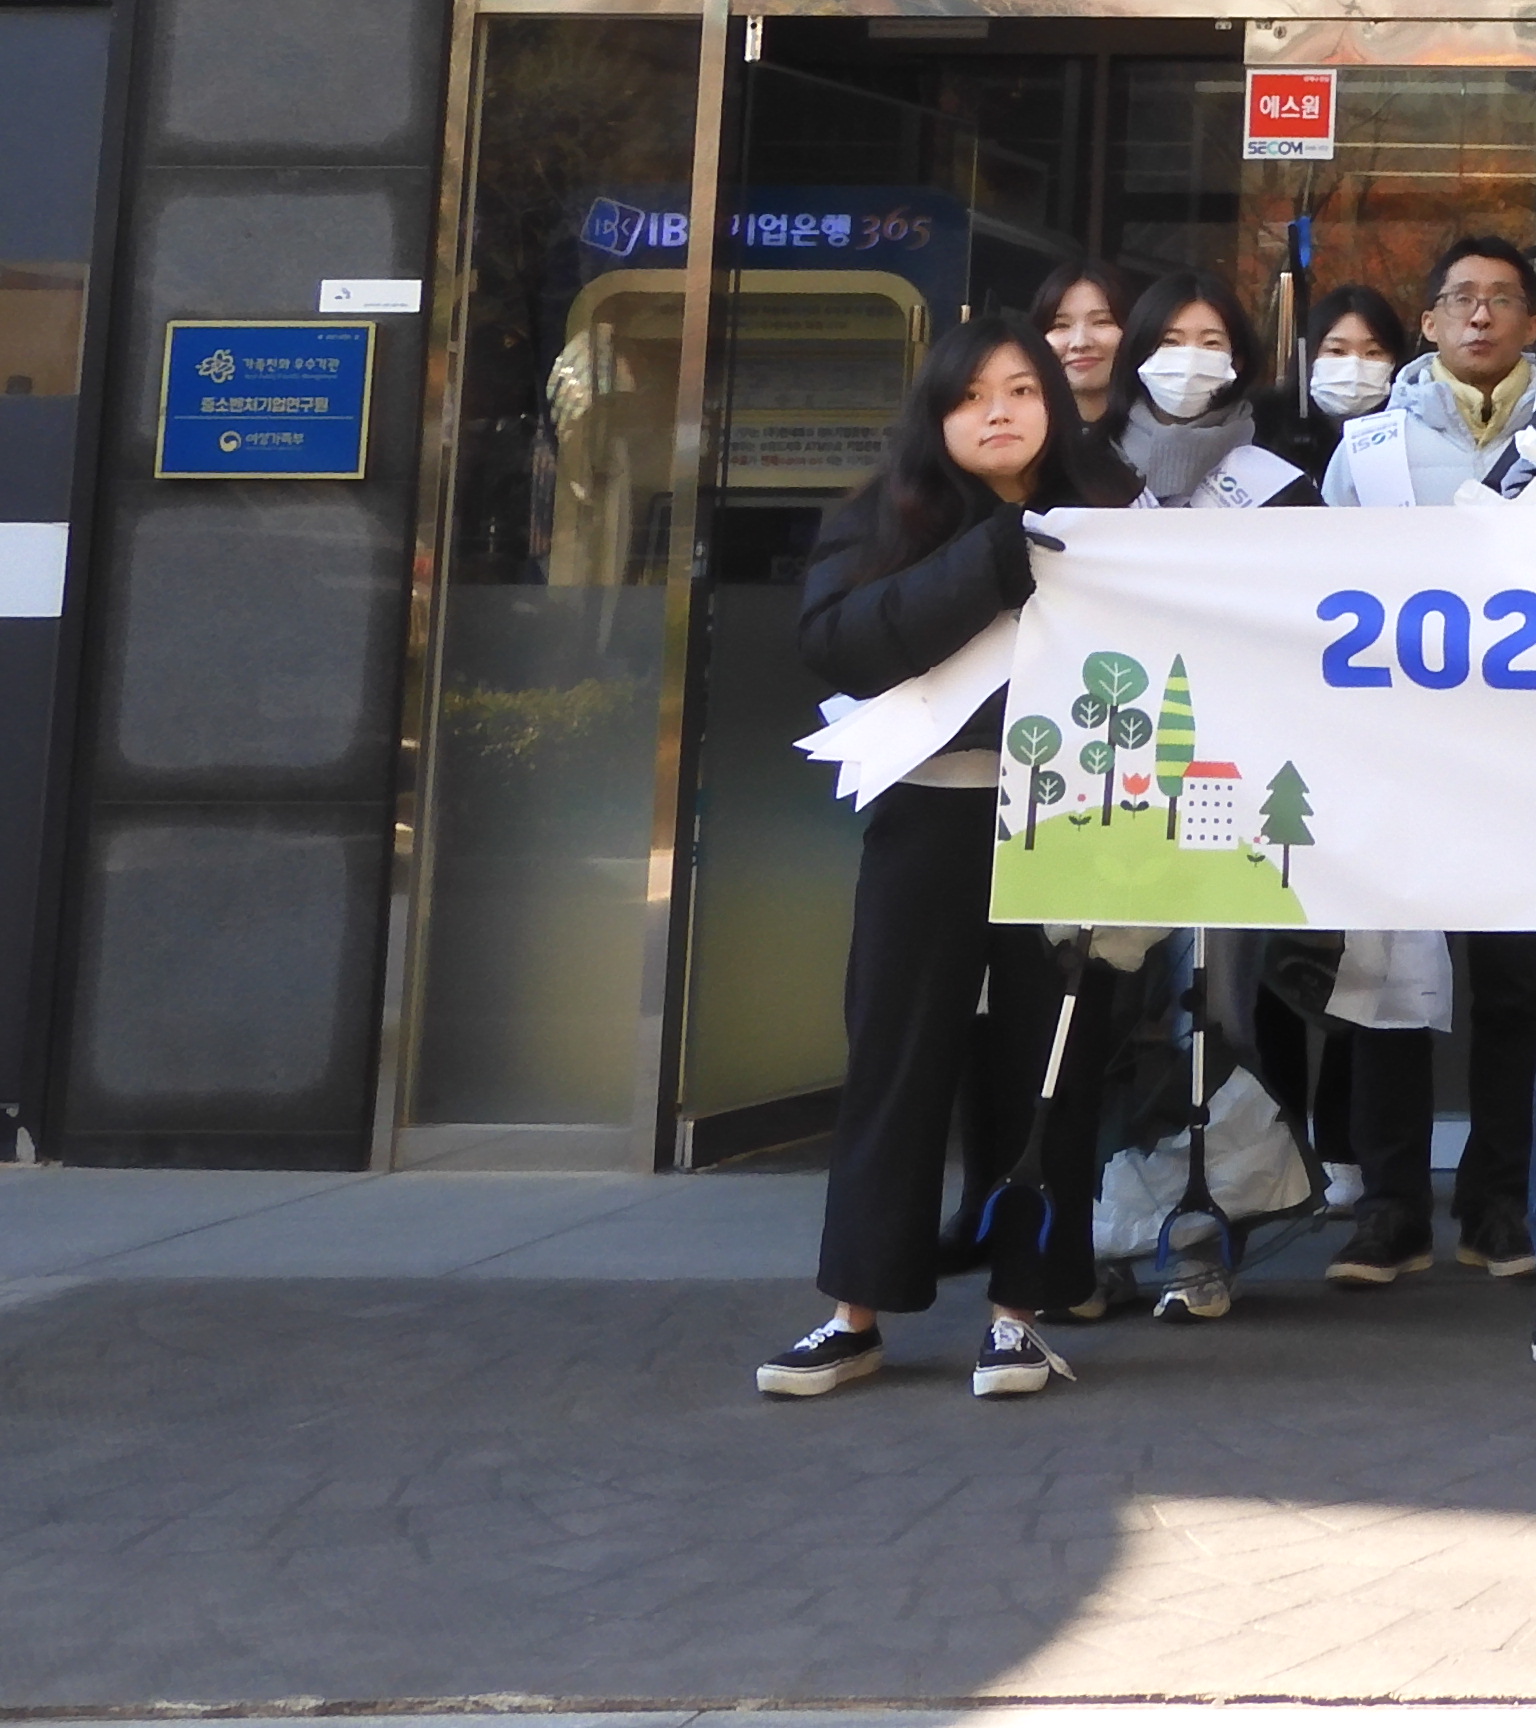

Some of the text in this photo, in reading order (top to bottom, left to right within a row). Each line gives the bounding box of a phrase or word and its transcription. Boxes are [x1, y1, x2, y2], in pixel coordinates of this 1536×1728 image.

[1260, 95, 1319, 119] 에스원
[1248, 141, 1303, 155] SECOM
[856, 207, 932, 250] 365
